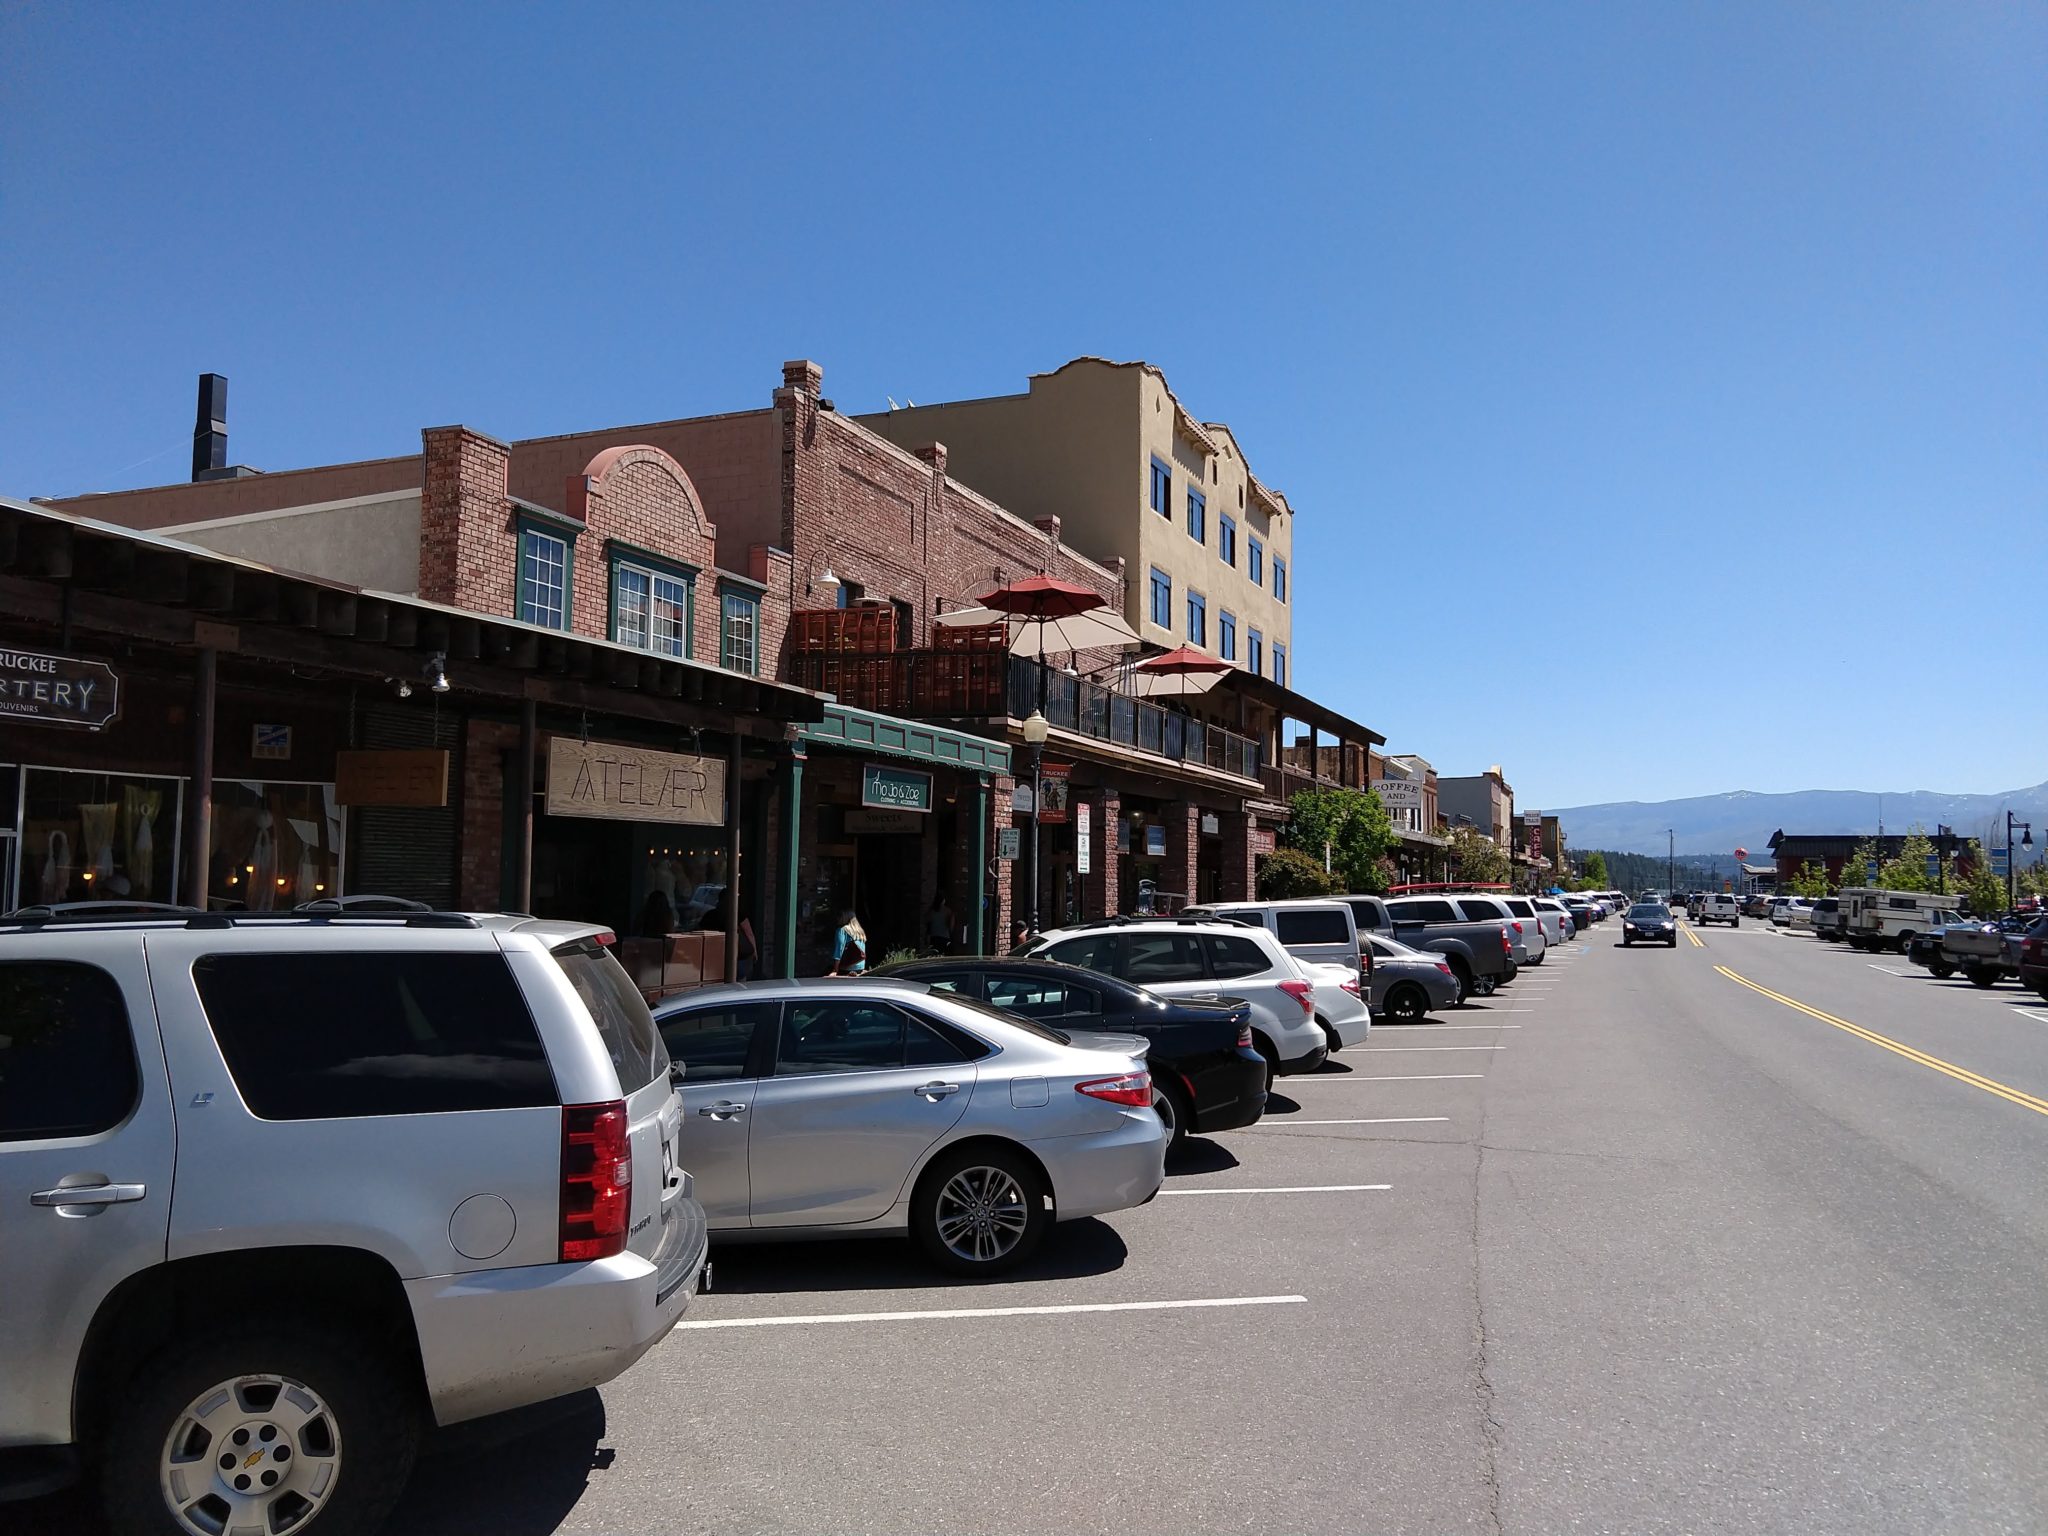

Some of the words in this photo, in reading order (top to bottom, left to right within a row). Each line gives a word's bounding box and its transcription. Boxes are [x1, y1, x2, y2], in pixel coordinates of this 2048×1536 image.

[345, 765, 437, 791] TELER
[571, 758, 706, 810] ATELIER
[1373, 782, 1420, 794] COFFEE
[1387, 792, 1406, 800] AND
